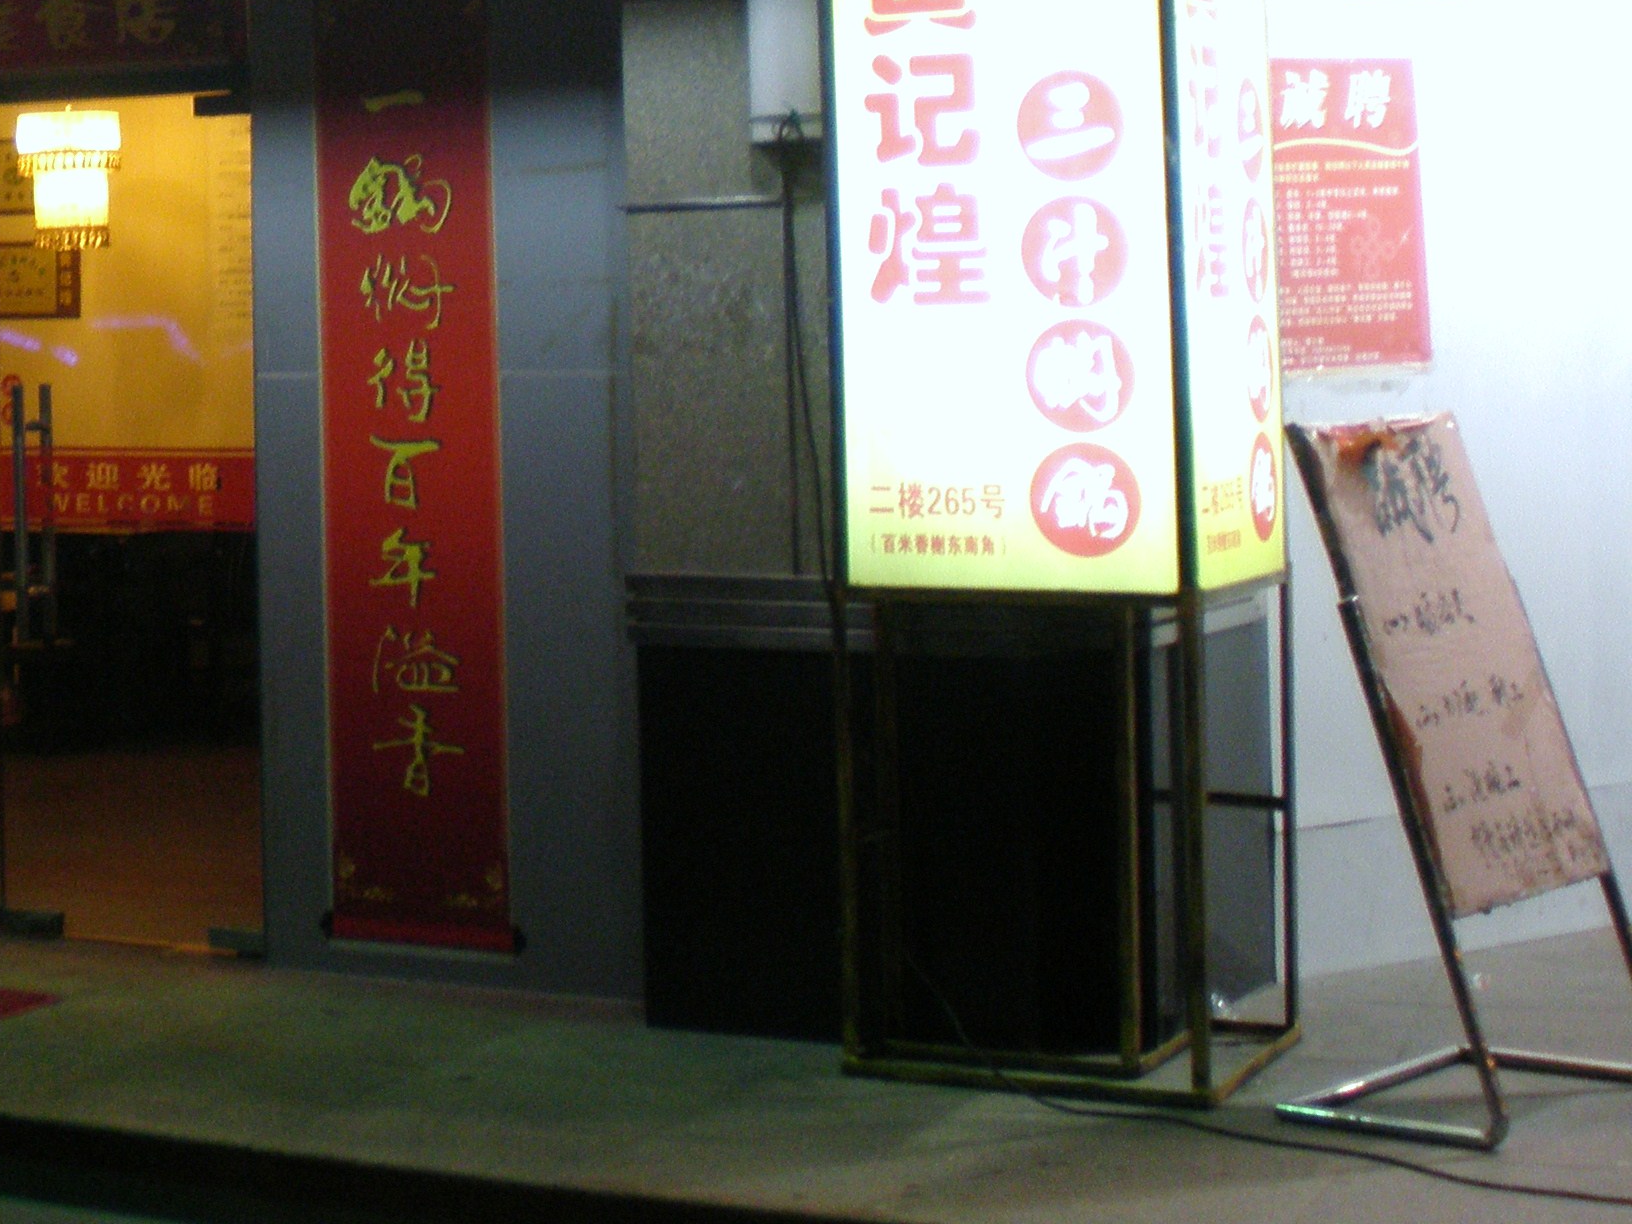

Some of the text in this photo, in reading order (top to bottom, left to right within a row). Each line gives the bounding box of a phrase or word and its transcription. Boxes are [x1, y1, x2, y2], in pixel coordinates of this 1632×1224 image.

[37, 461, 222, 491] 欢迎光临
[52, 492, 215, 517] WELCOME
[869, 482, 1006, 520] 二楼265号
